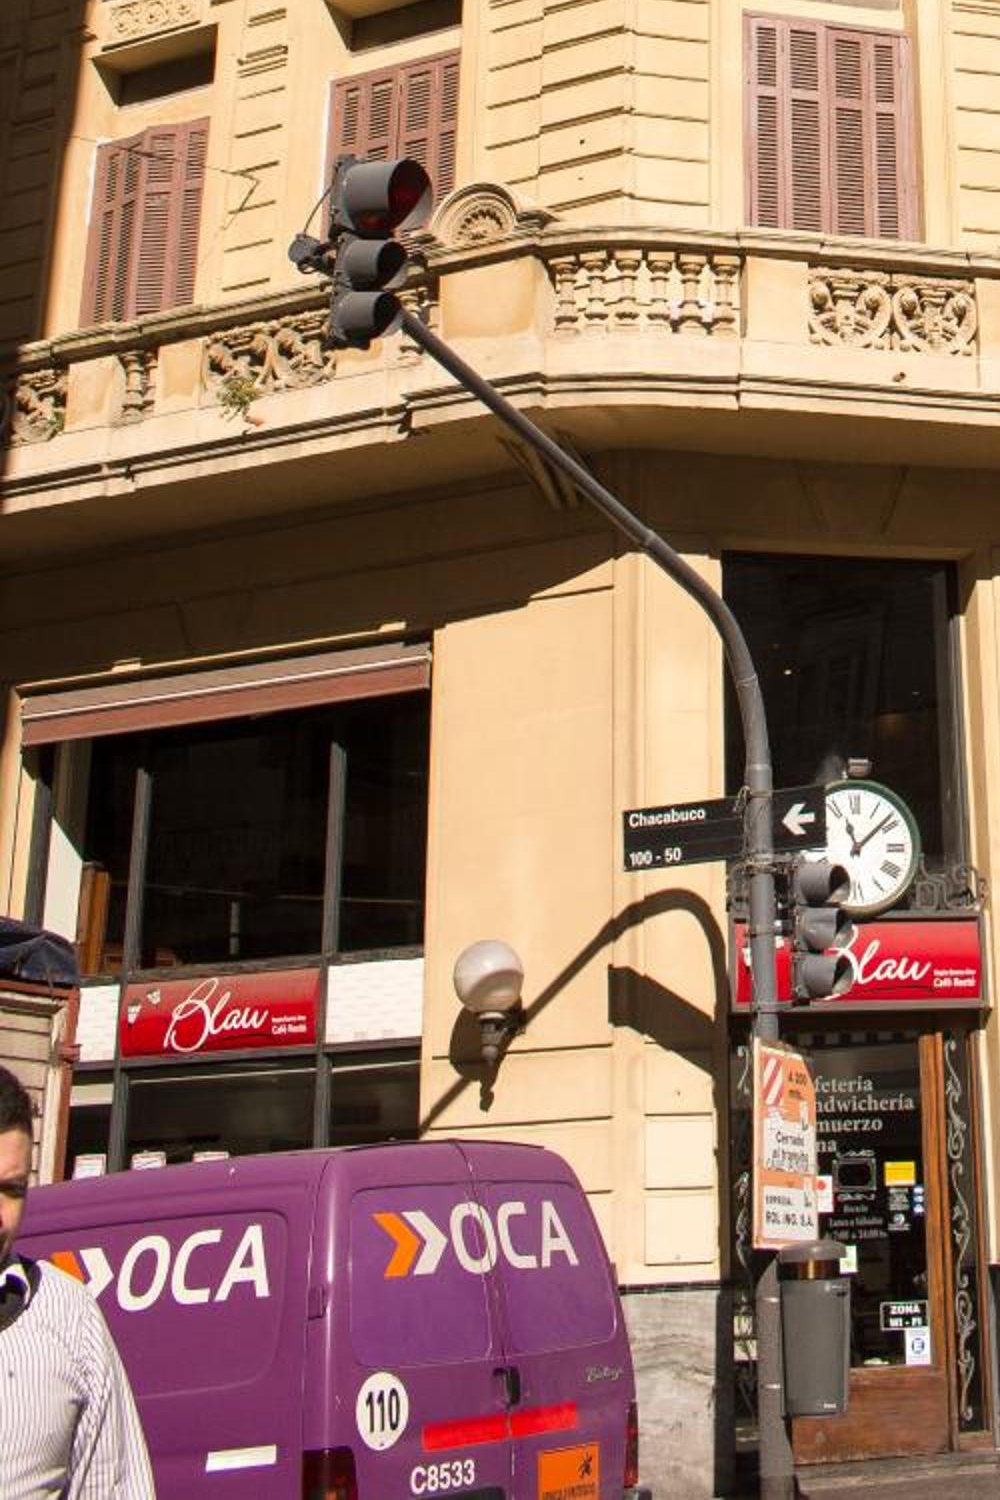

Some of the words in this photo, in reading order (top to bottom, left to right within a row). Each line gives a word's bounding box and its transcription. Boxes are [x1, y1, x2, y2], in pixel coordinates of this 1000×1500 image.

[628, 807, 706, 828] Chacabuco
[629, 851, 652, 867] 100
[664, 847, 682, 863] 50
[163, 977, 268, 1052] Blau
[816, 1093, 914, 1113] ndwichería
[816, 1118, 883, 1133] muerzo
[816, 1140, 837, 1152] na
[449, 1200, 580, 1275] OCA
[116, 1223, 271, 1312] OCA
[889, 1304, 921, 1315] ZONA
[365, 1387, 401, 1434] 110
[410, 1458, 476, 1495] C8533
